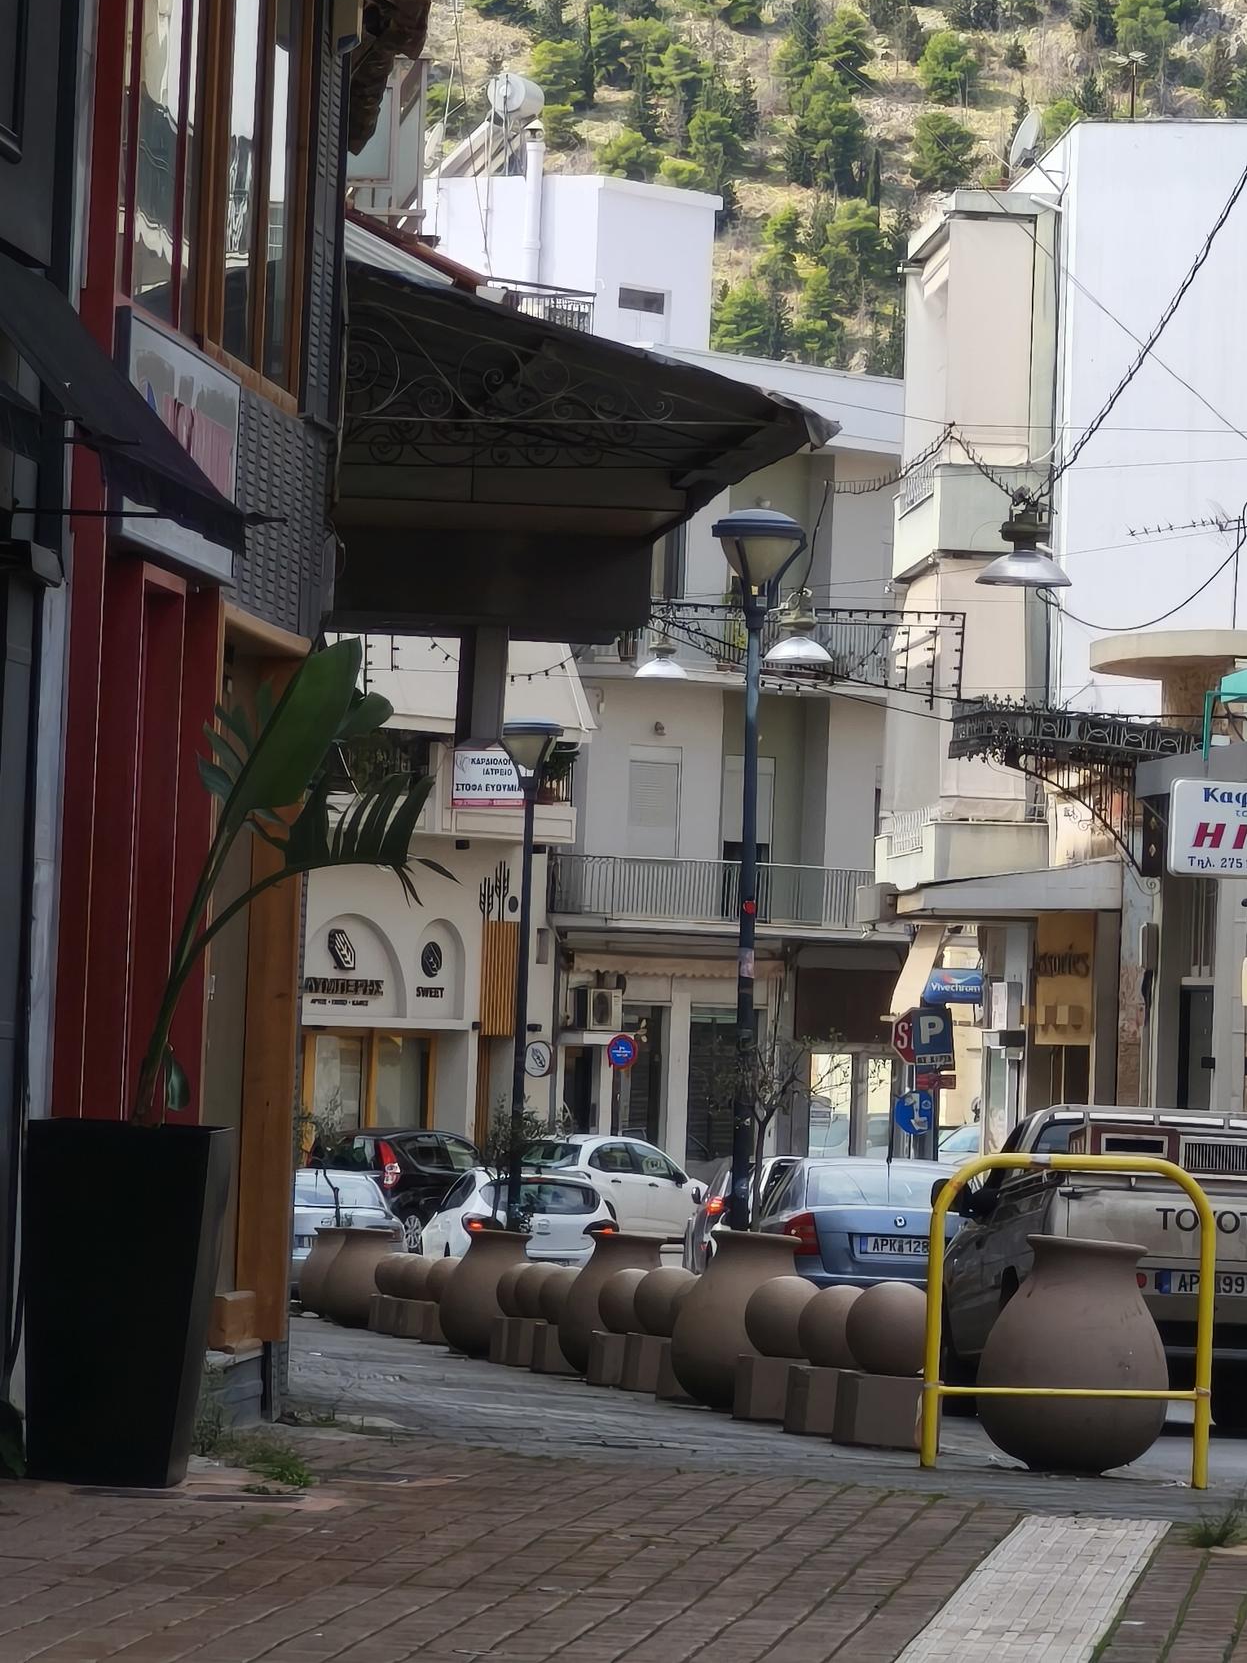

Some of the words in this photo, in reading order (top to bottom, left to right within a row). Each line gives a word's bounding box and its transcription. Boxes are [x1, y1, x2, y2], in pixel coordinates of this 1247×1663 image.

[482, 768, 512, 776] ΙΑΤΡΕΙΟ
[1192, 822, 1227, 849] Η
[1188, 856, 1216, 870] Τηλ.
[416, 986, 445, 998] SWEET
[930, 982, 981, 993] Vivechrom
[919, 1015, 945, 1045] P
[1178, 1276, 1200, 1292] AP
